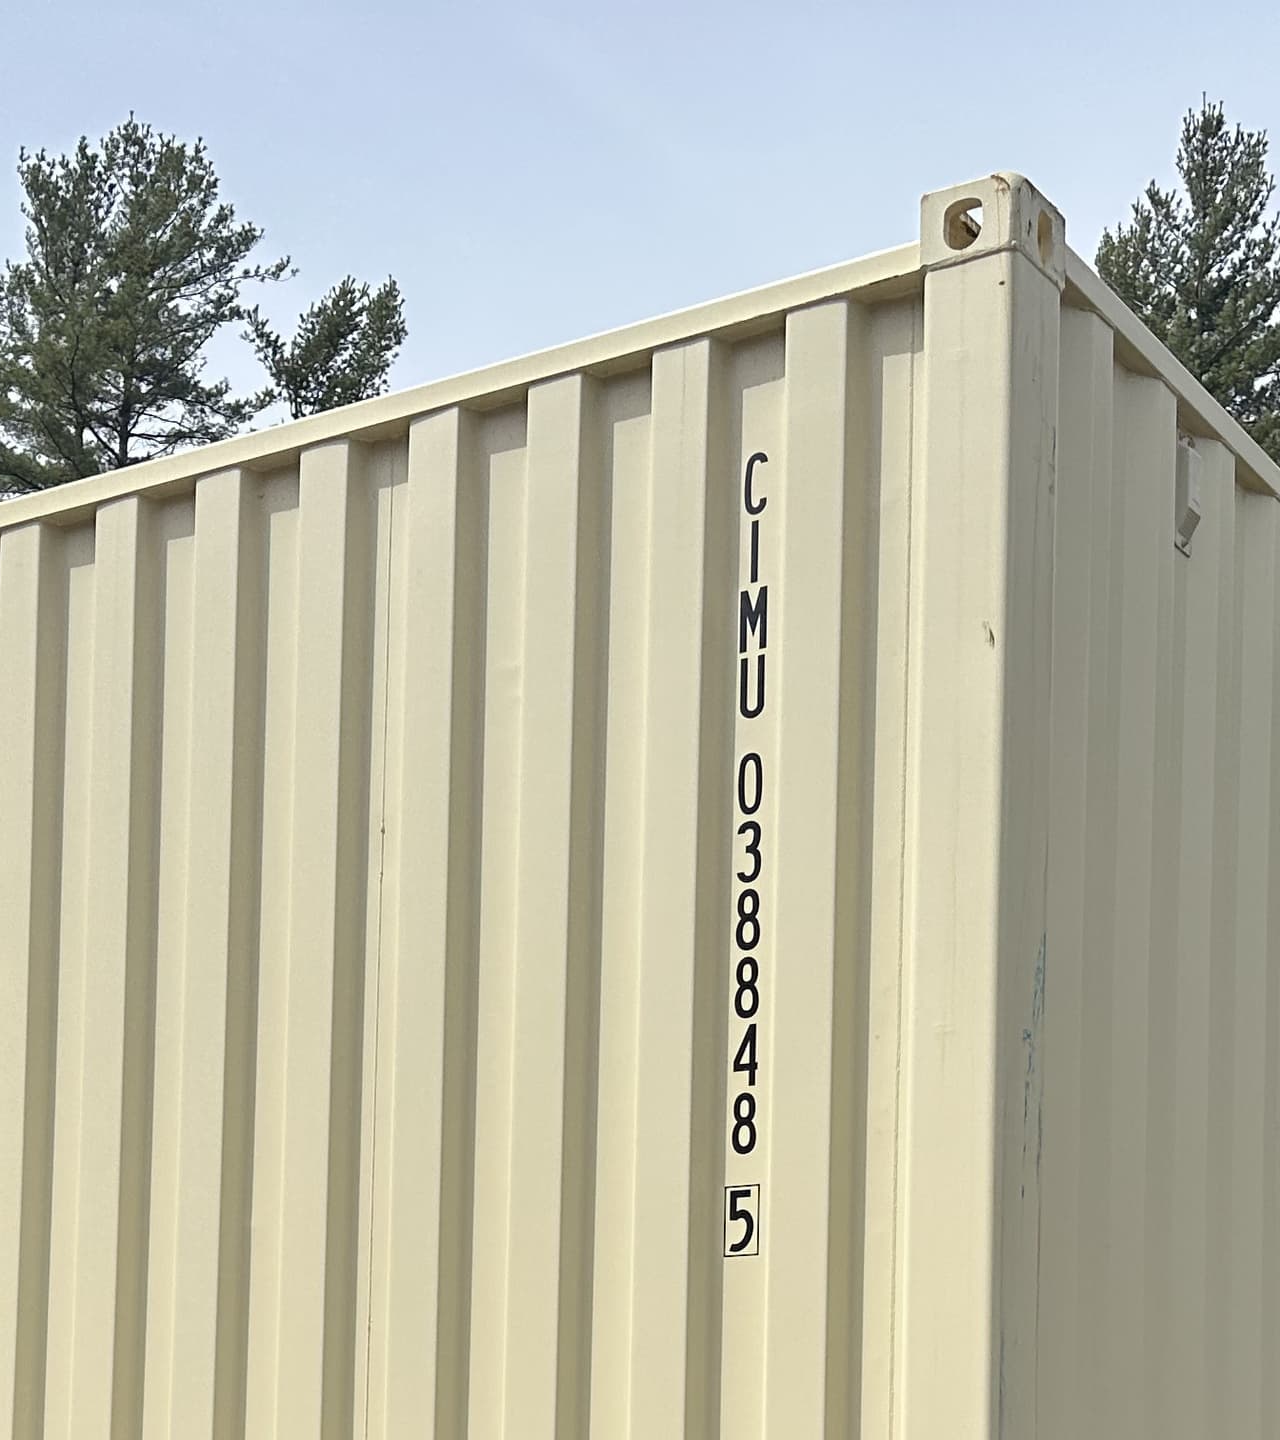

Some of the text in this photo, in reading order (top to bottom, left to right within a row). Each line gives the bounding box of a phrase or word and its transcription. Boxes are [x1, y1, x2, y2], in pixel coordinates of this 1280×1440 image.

[726, 452, 769, 1255] CIMU 038848 5
